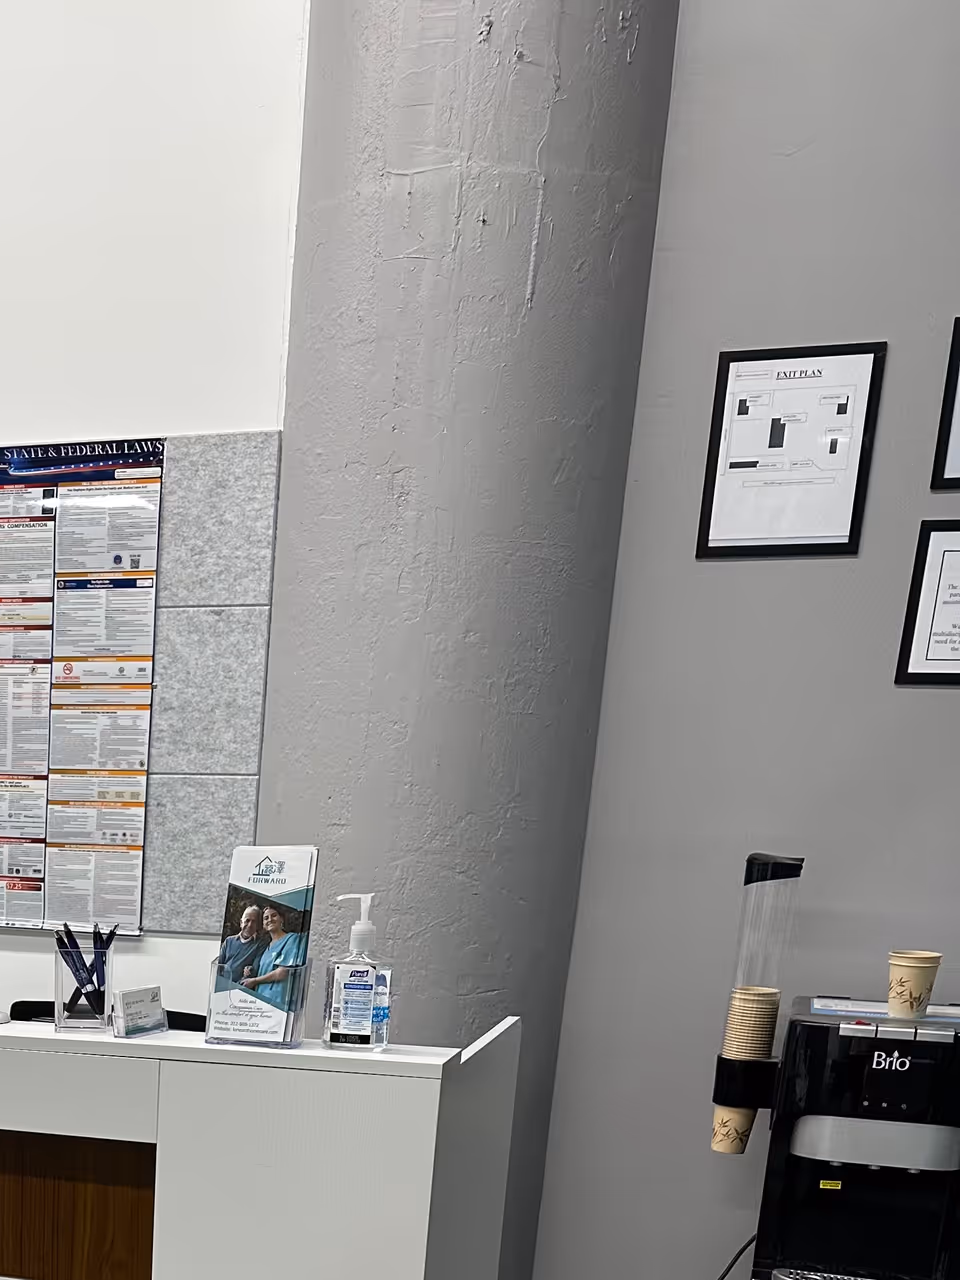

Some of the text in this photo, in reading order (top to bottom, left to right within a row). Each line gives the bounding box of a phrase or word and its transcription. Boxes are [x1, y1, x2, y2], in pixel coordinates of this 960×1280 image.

[777, 370, 798, 379] EXIT
[799, 369, 823, 377] PLAN
[4, 441, 163, 459] STATE & FEDERAL LAWS
[872, 1050, 910, 1071] Brio
